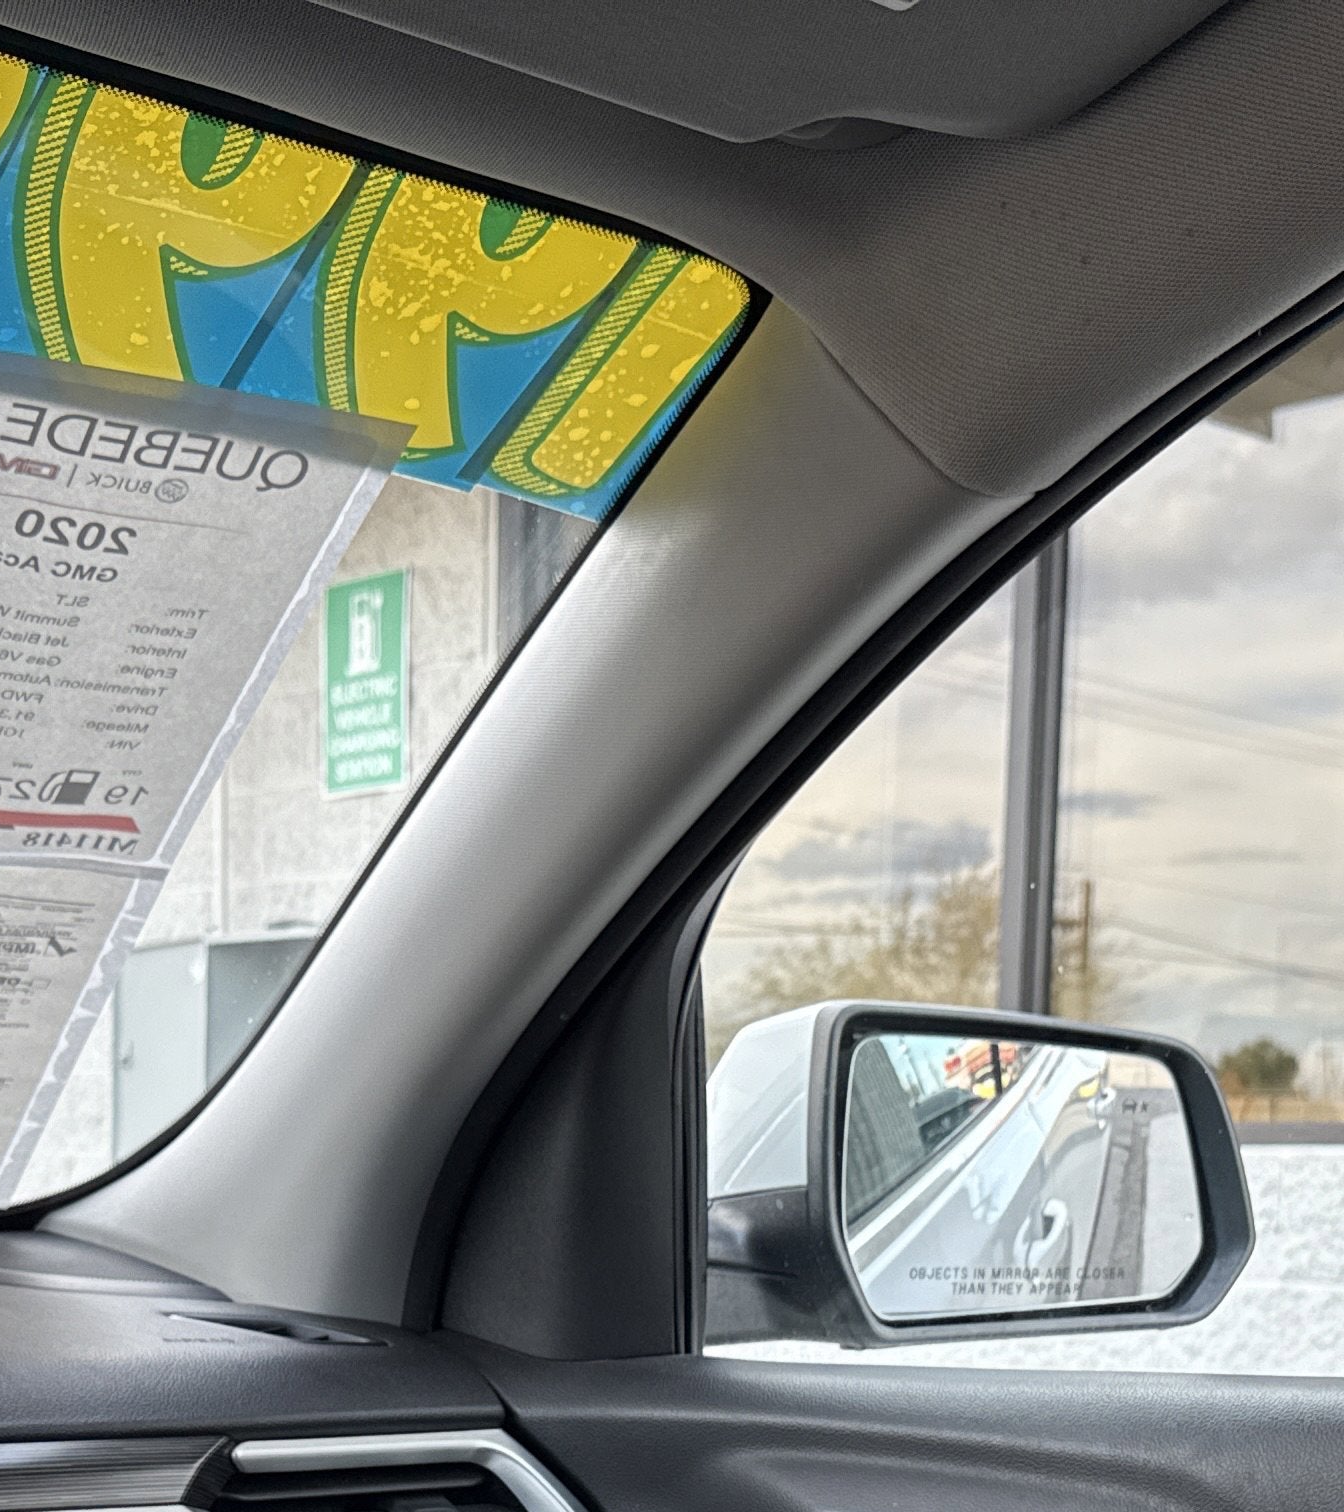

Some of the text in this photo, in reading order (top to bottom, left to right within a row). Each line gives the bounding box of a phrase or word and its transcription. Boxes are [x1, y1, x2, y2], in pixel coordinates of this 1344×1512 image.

[909, 1266, 1125, 1281] OBJECTS IN MIRROR ARE CLOSER
[951, 1282, 1080, 1295] THAN THEY APPEAR
